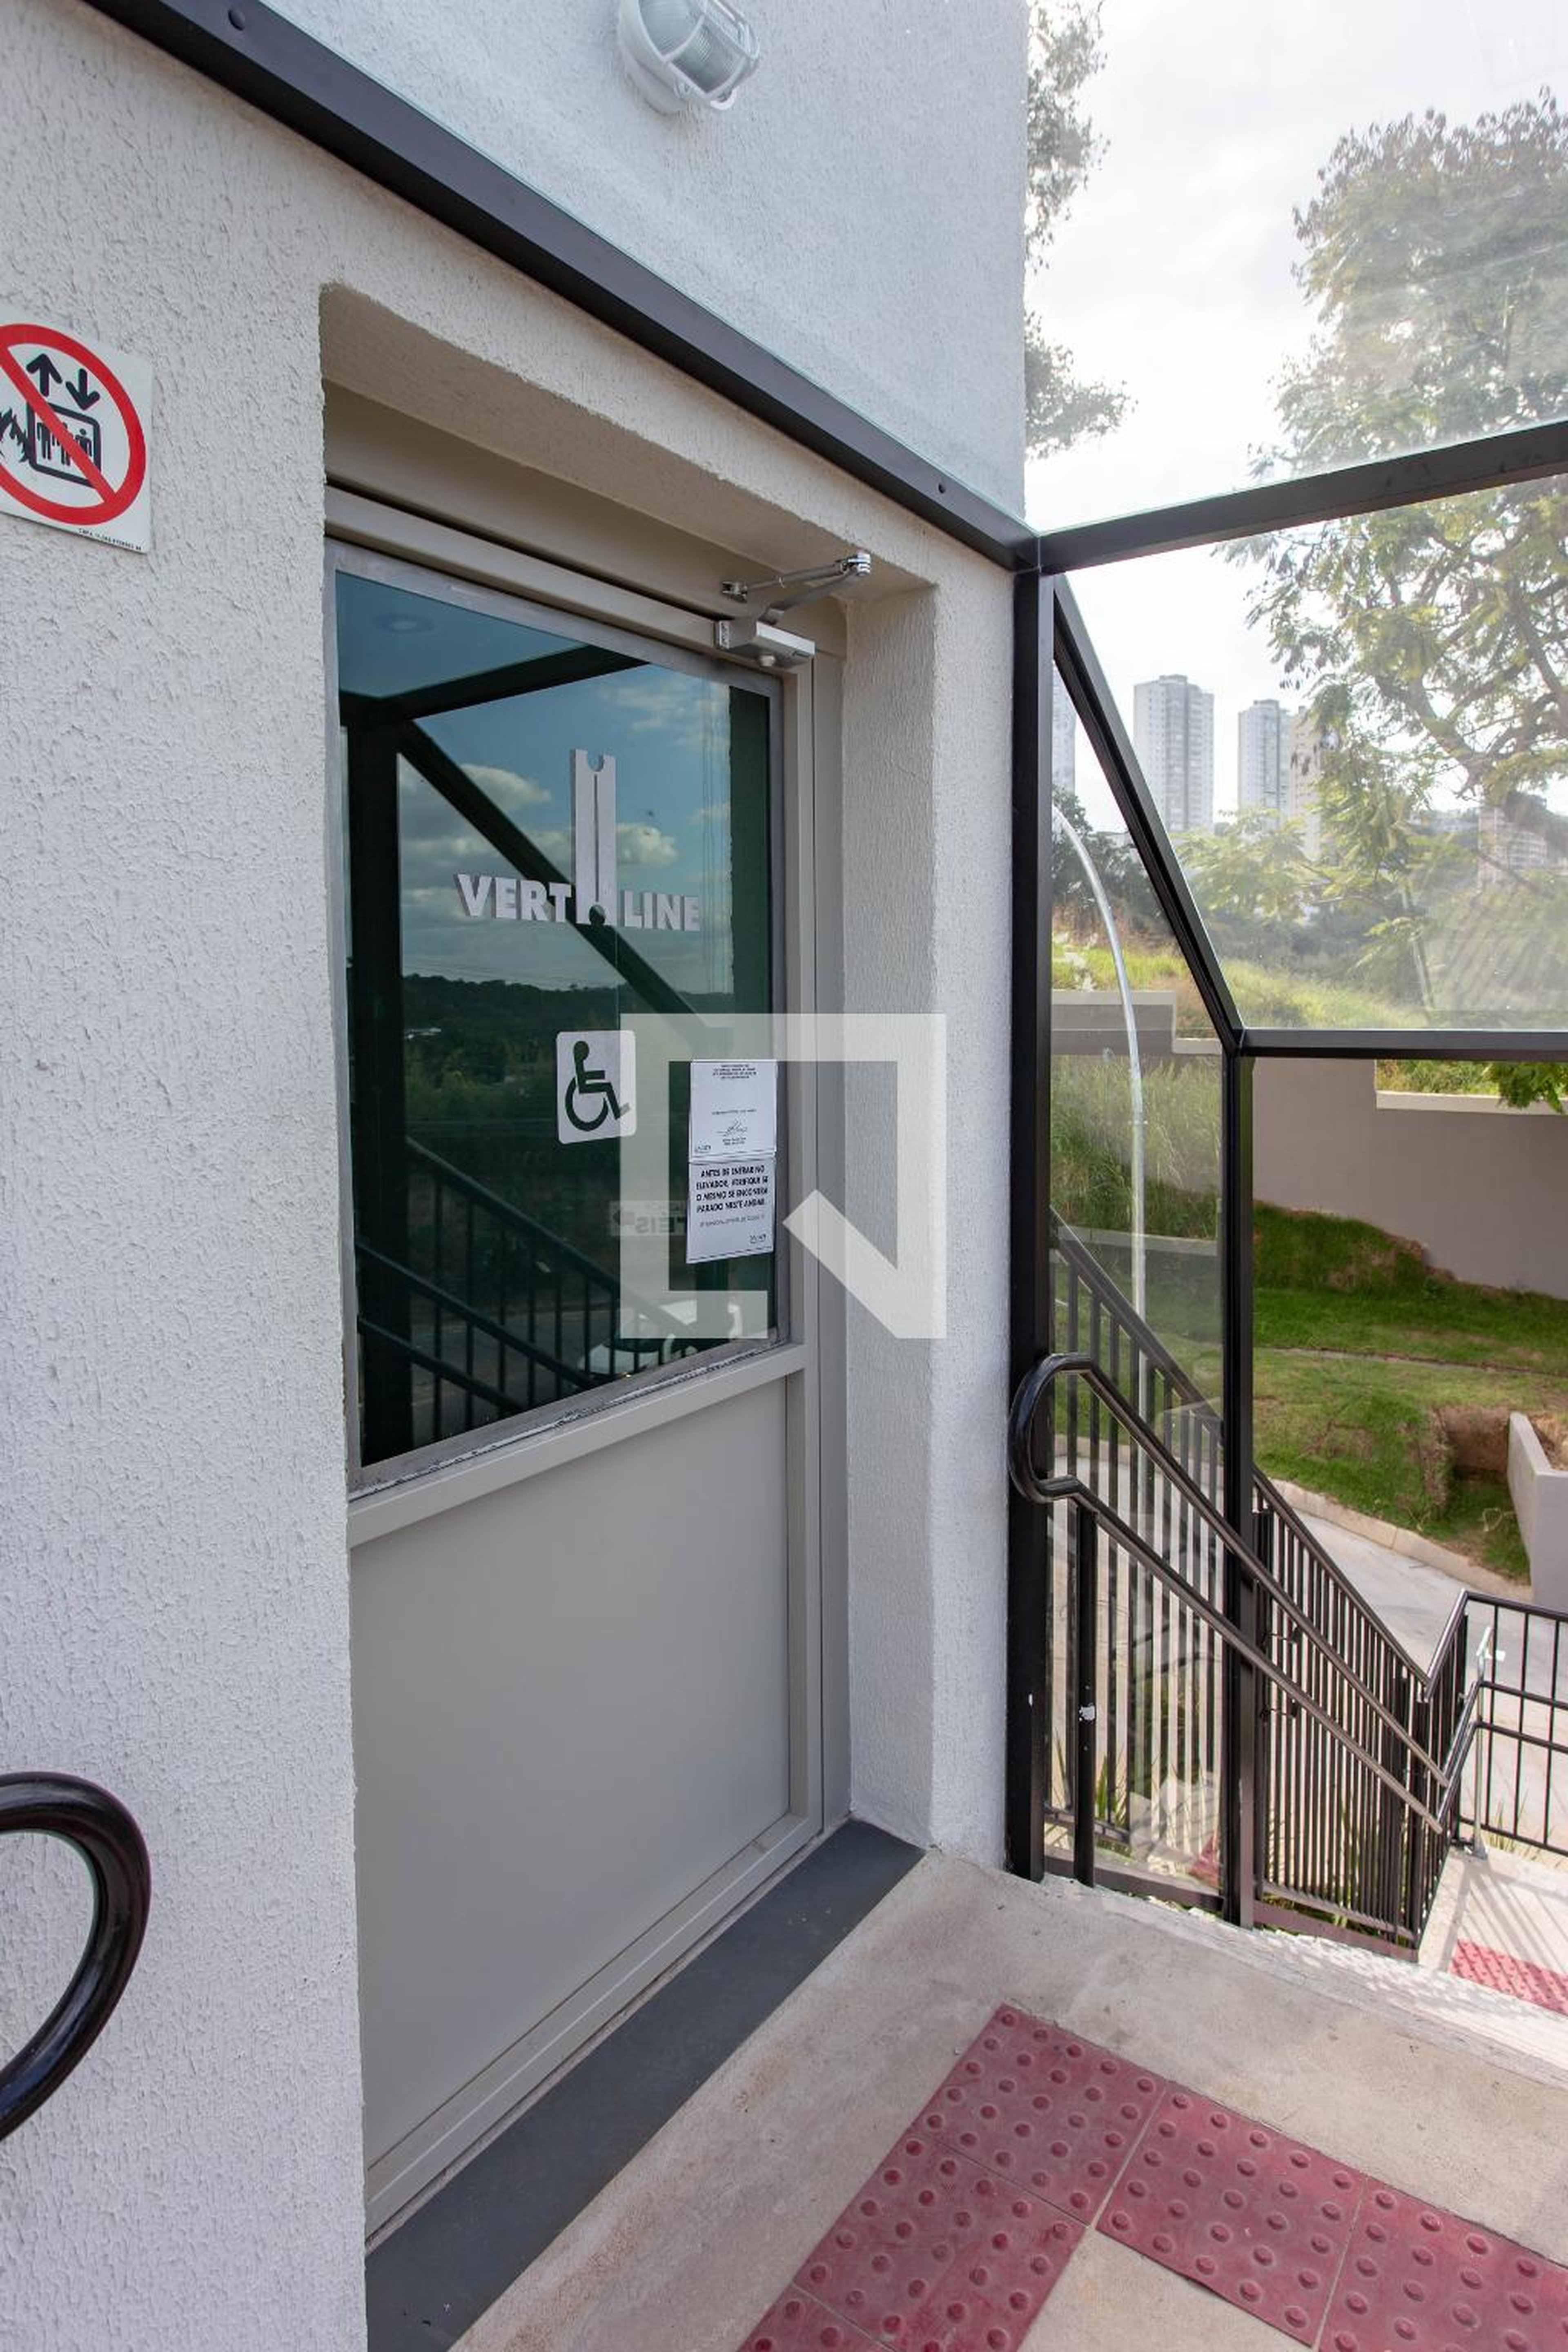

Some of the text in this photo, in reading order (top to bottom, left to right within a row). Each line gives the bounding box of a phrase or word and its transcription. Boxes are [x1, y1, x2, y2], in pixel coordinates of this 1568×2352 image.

[701, 1165, 765, 1178] ANTES DE ENTRAR NO
[704, 1191, 726, 1200] MESMO
[728, 1190, 735, 1198] SE
[697, 1203, 723, 1213] PARADO
[725, 1200, 743, 1209] NESTE
